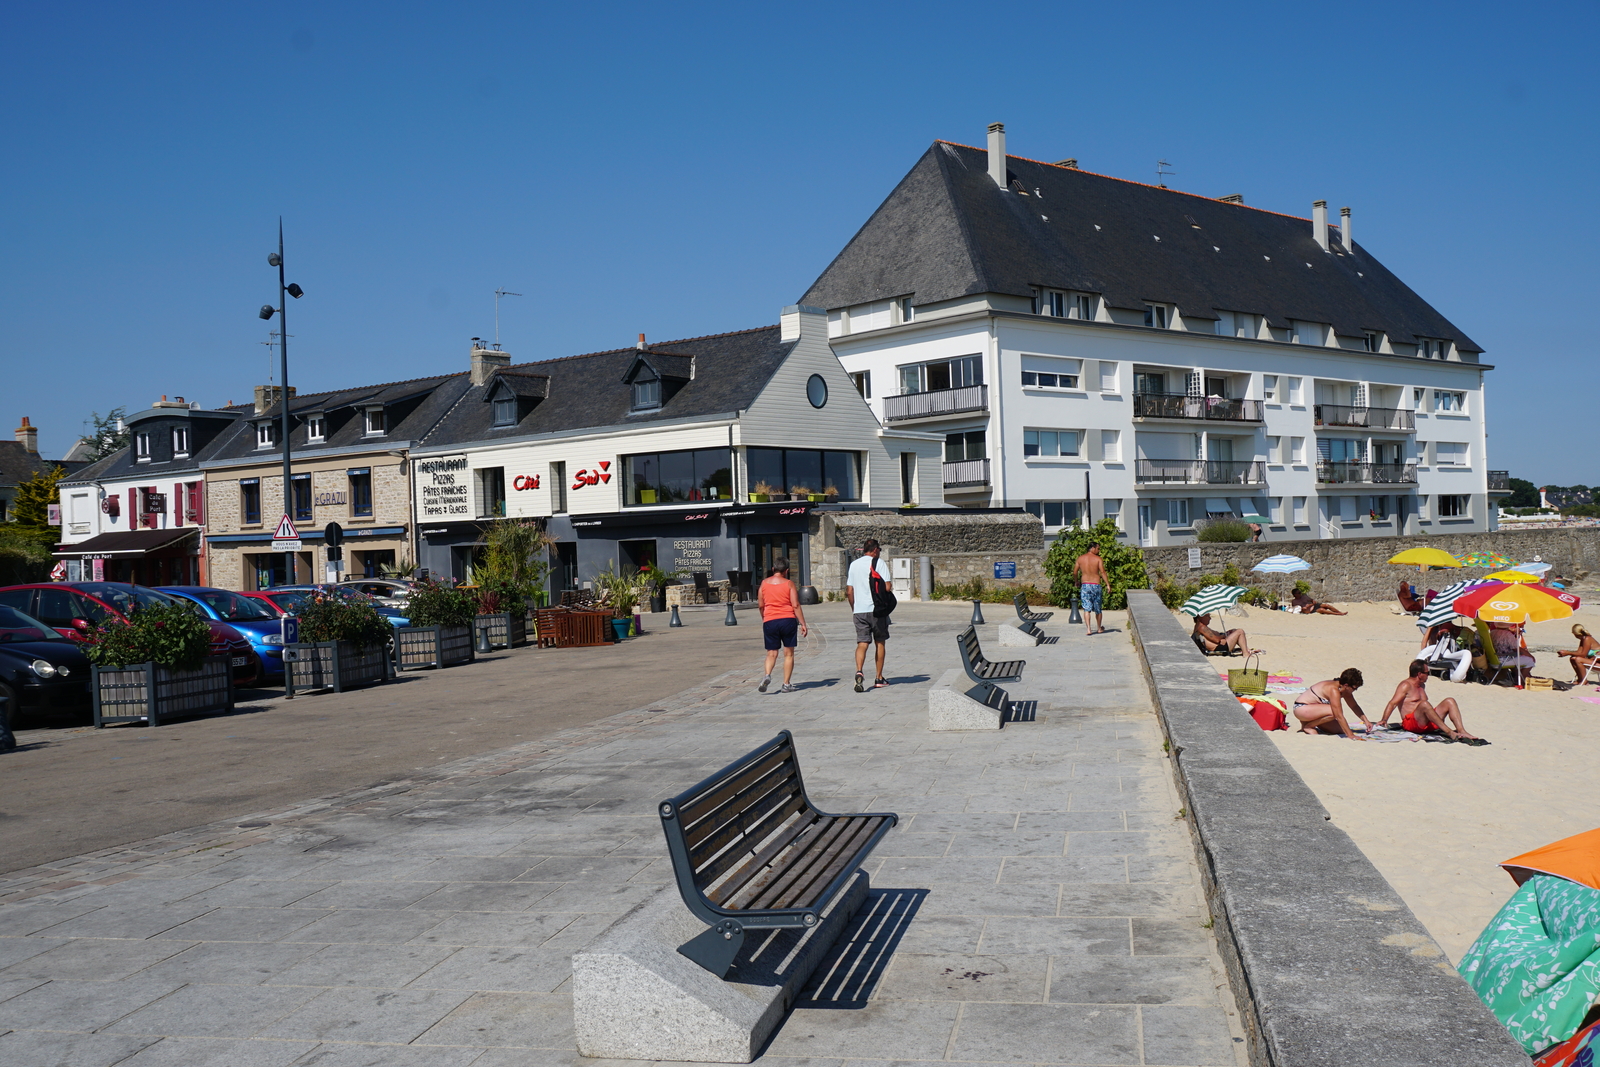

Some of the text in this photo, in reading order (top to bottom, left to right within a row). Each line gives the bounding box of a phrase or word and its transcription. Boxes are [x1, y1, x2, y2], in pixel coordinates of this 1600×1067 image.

[422, 459, 466, 474] RESTAURANT
[433, 473, 456, 485] PIZZAS
[513, 469, 600, 491] Côté Sud
[424, 504, 468, 515] TAPAS GLACES
[673, 540, 712, 550] RESTAURANT
[683, 549, 702, 558] PIZZAS
[287, 622, 296, 640] P
